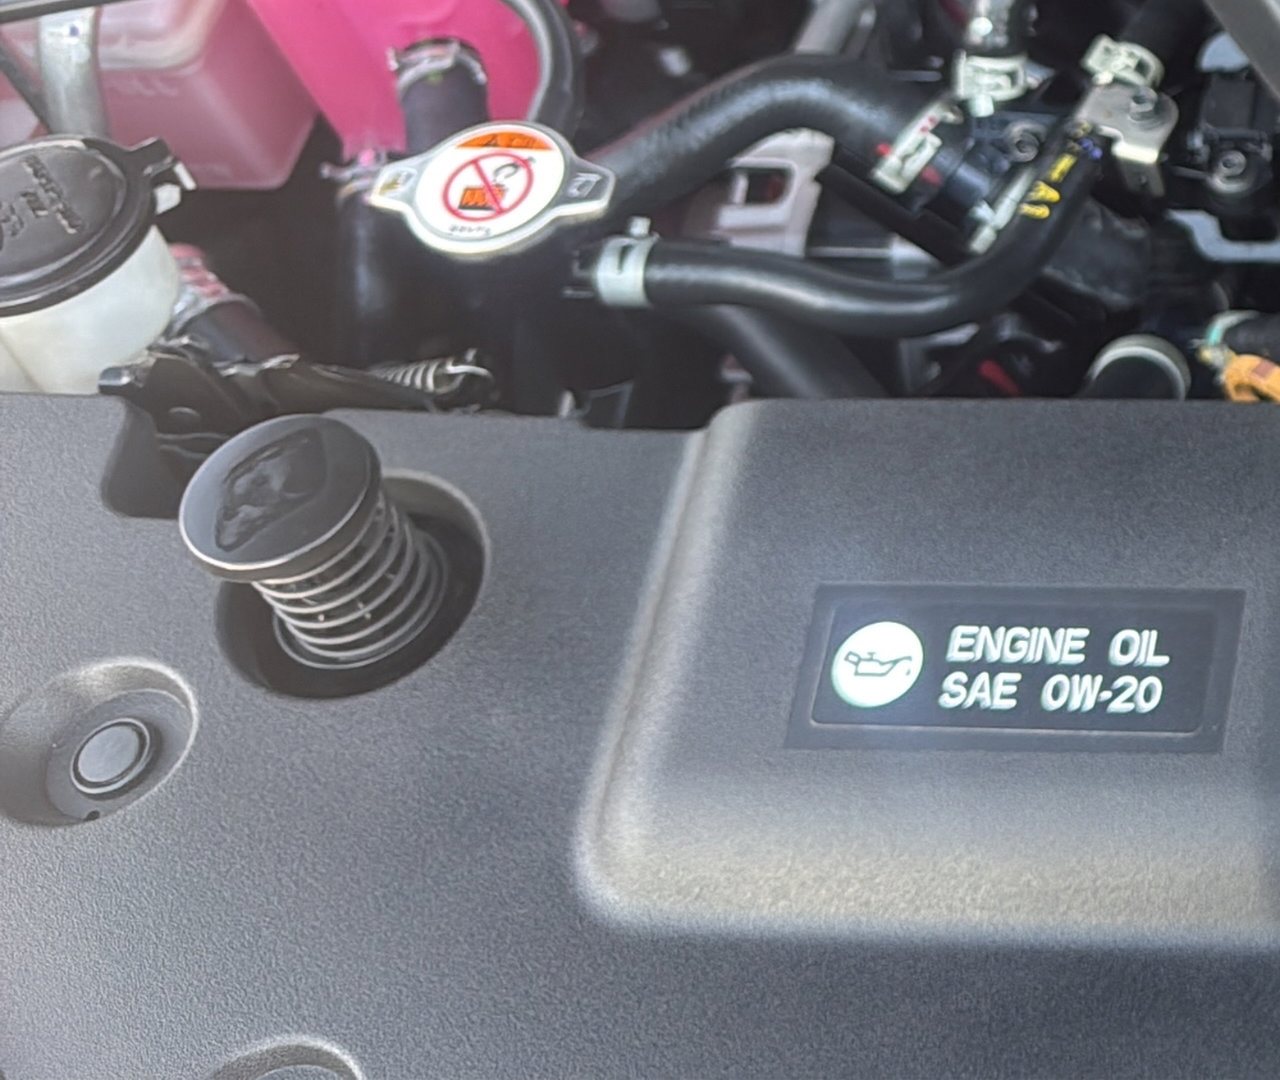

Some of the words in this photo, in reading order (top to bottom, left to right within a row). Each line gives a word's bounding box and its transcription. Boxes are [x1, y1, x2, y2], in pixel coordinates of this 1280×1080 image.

[945, 624, 1091, 666] ENGINE
[1107, 628, 1171, 668] OIL
[937, 670, 1023, 710] SAE
[1040, 673, 1164, 714] 0W-20
